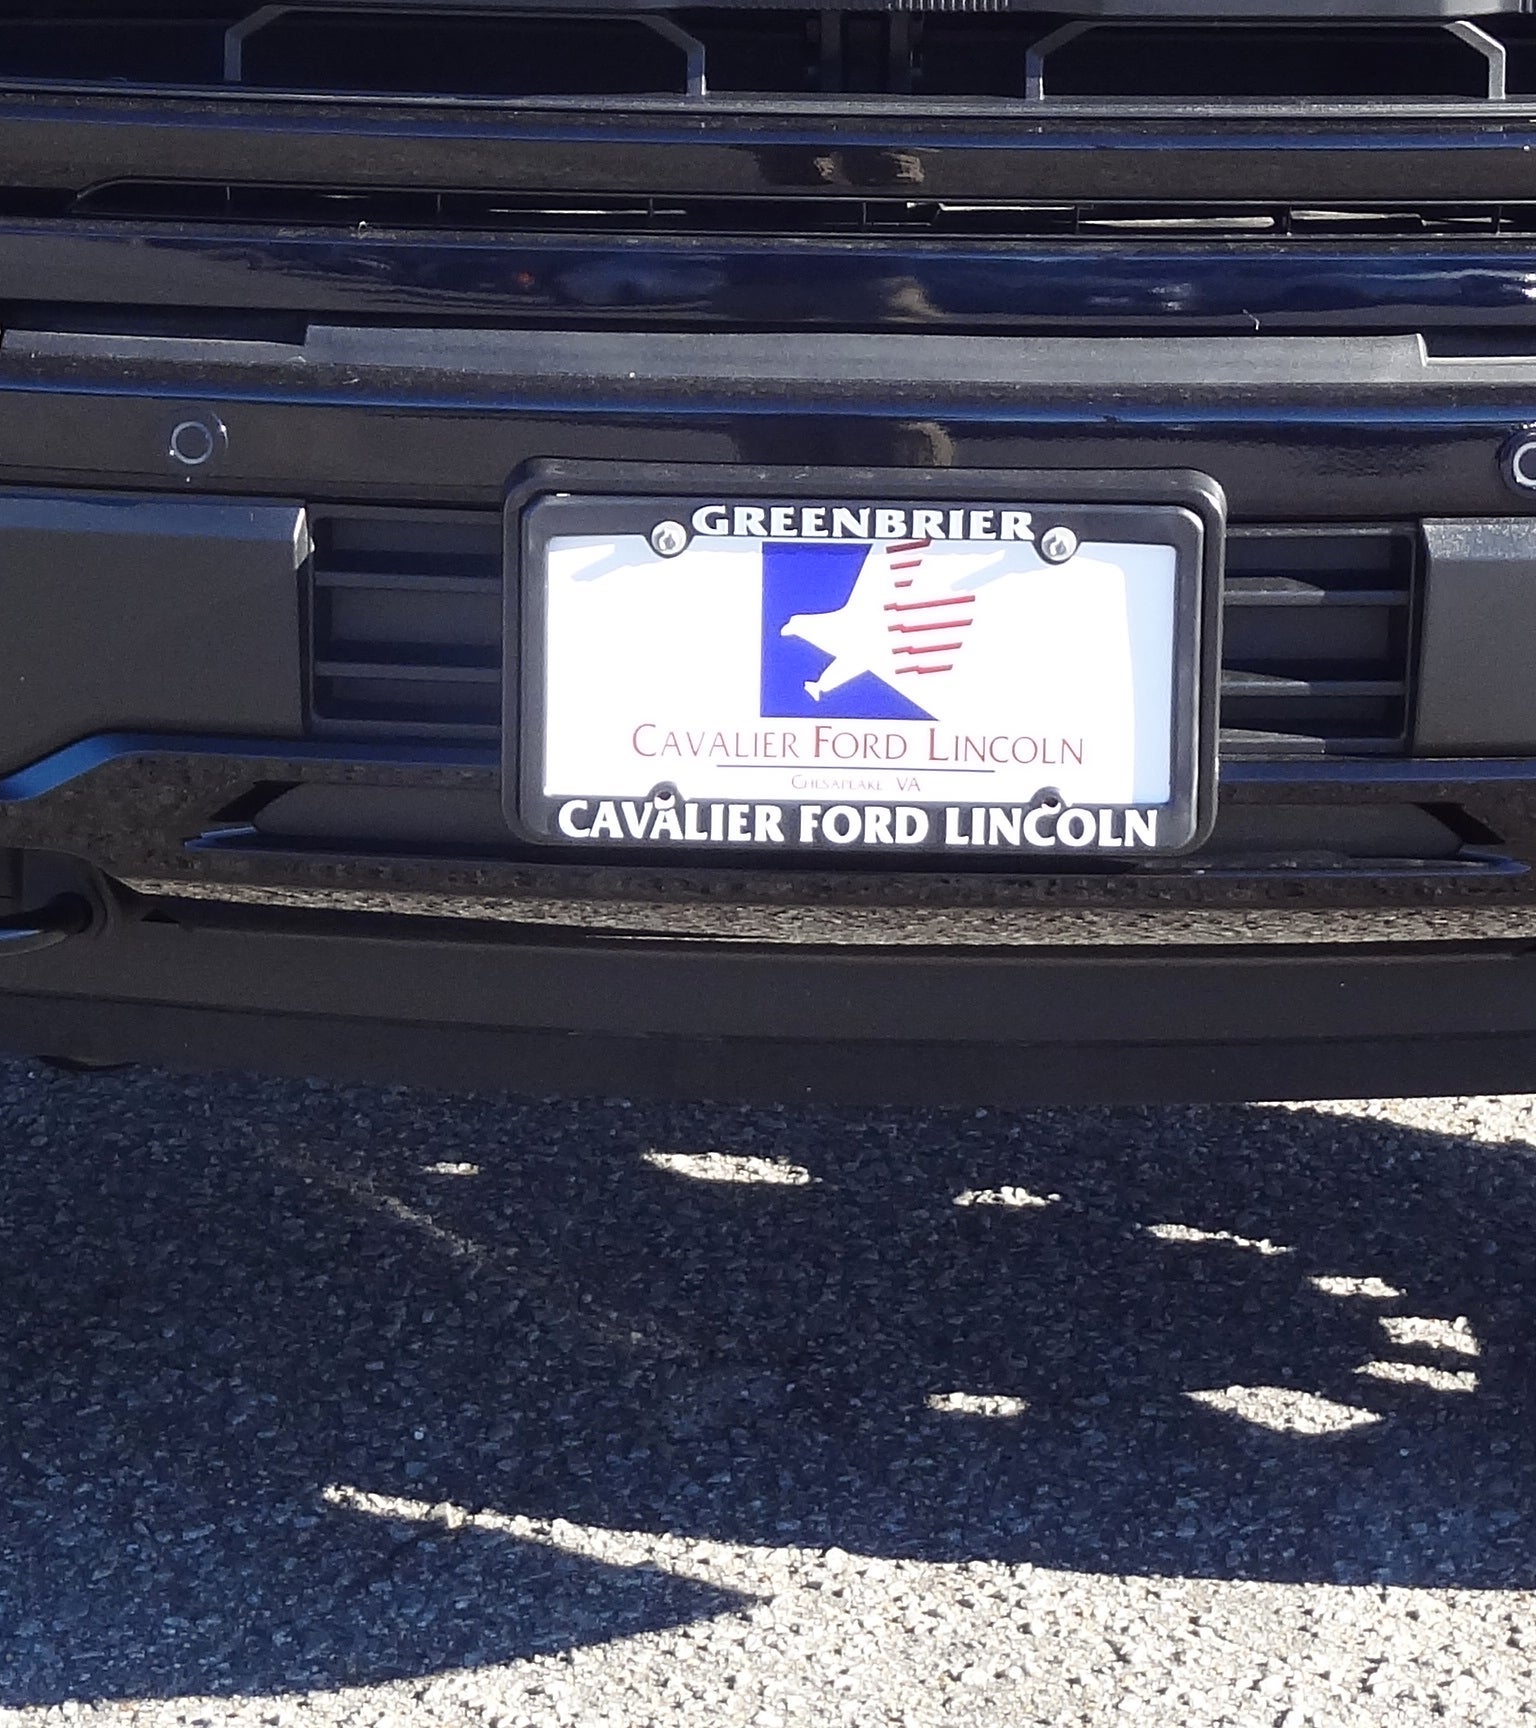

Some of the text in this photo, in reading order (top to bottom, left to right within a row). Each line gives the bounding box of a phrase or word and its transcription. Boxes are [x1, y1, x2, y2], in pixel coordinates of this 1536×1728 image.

[691, 504, 1037, 541] GREENBRIER
[632, 724, 1084, 766] CAVALIER FORD LINCOLN
[896, 776, 922, 793] VA
[559, 798, 1158, 849] CAVALIER FORD LINCOLN
